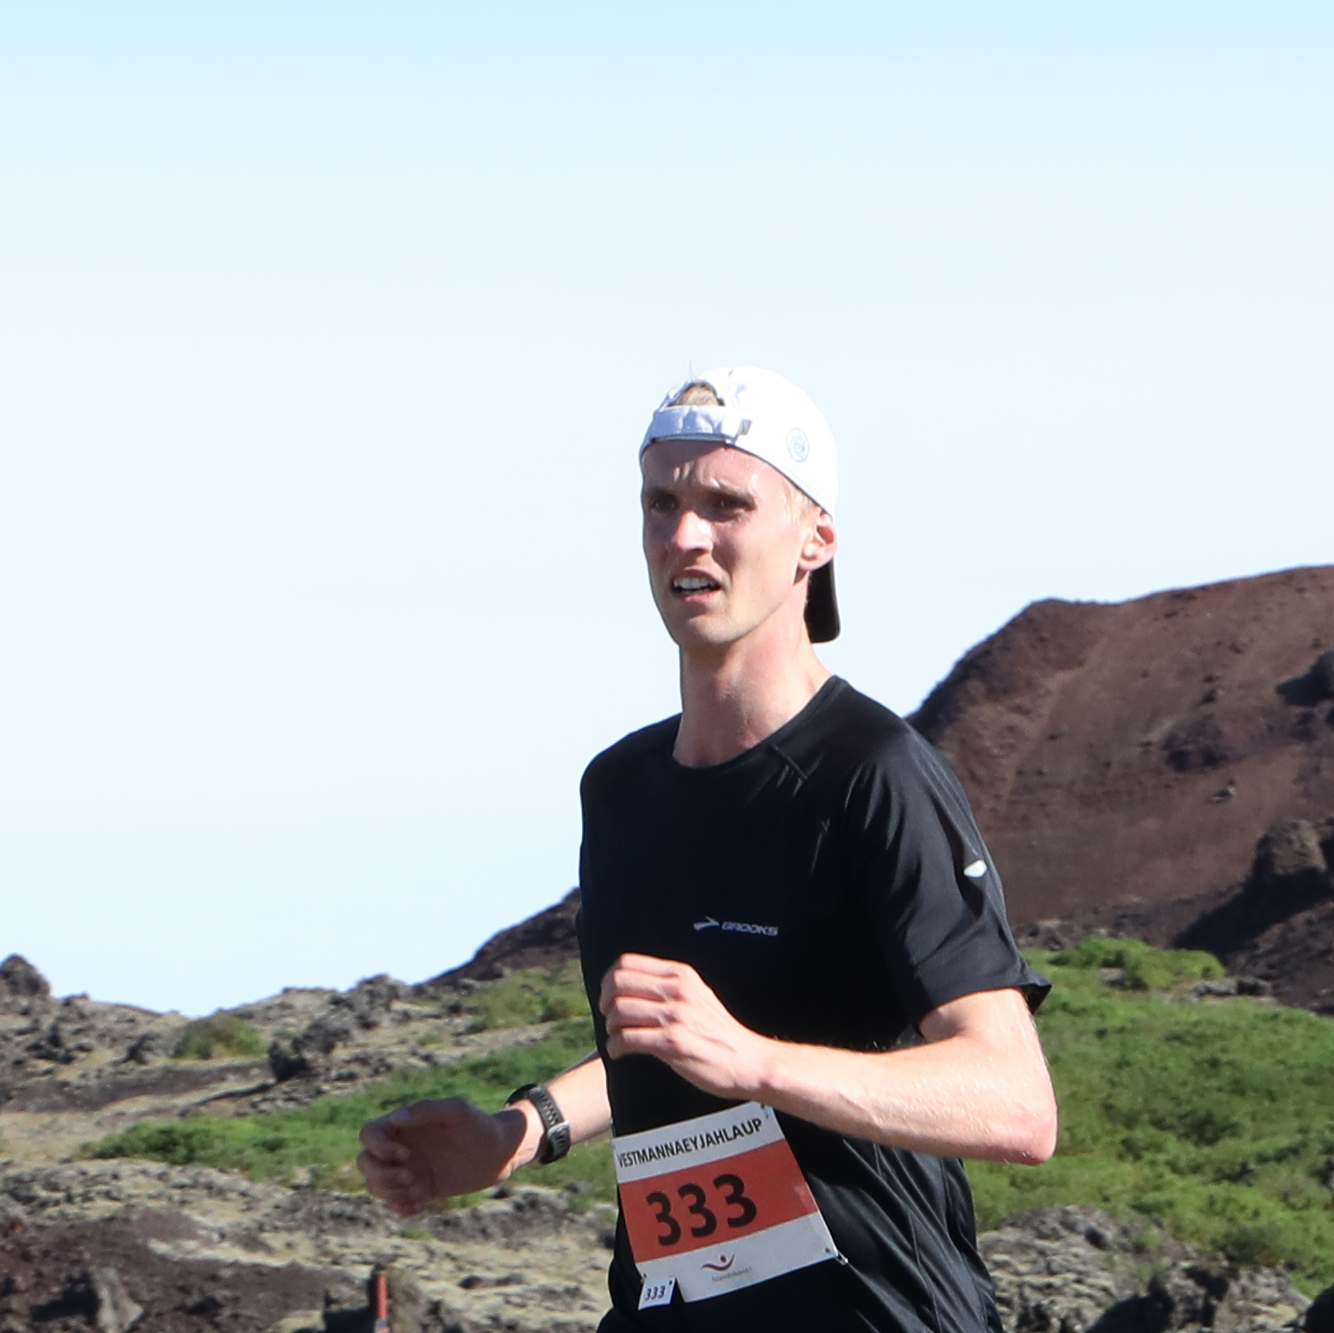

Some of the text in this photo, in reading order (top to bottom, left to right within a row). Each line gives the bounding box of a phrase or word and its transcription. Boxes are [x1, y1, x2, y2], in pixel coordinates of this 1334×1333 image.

[721, 921, 779, 936] BROOKS
[618, 1117, 762, 1168] VESTMANNAEYJAHLAUP
[645, 1173, 757, 1246] 333
[644, 1285, 666, 1301] 333
